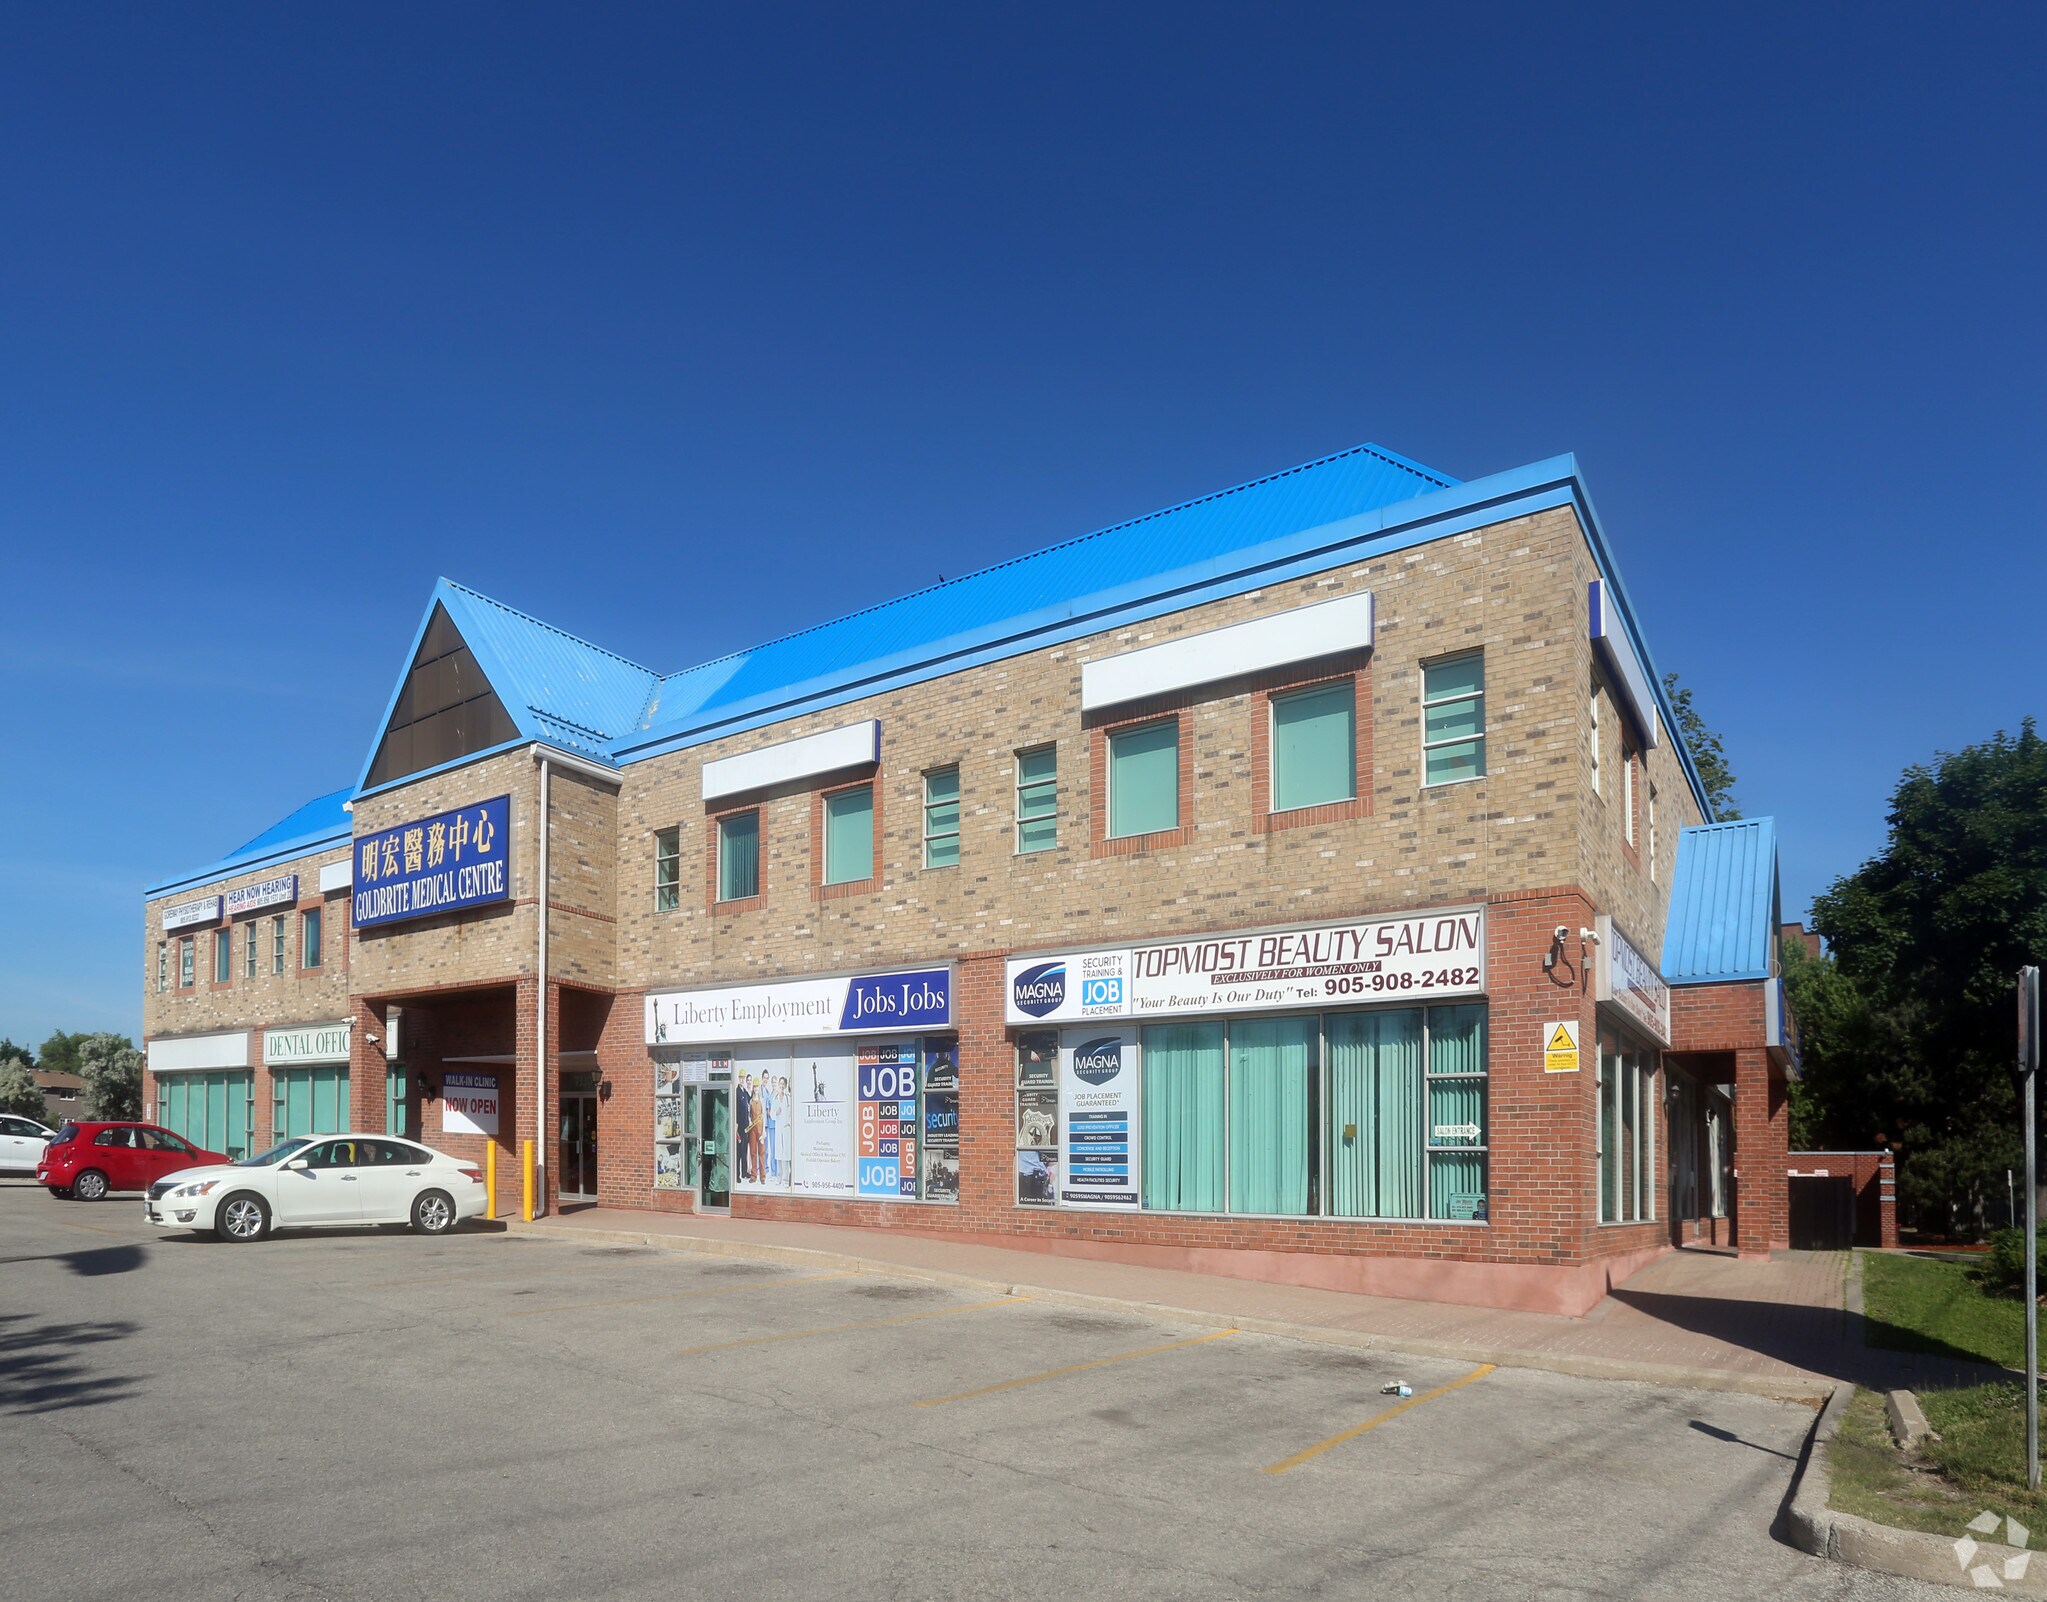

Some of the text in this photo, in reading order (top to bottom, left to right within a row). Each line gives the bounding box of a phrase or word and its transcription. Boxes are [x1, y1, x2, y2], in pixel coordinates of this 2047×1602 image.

[361, 809, 495, 883] 明宏醫務中心
[229, 877, 291, 905] HEAR NOW HEARING
[355, 860, 503, 922] GOLDBRITE MEDICAL CENTRE
[228, 901, 246, 912] HEARING
[247, 899, 256, 908] AIDS
[1134, 916, 1479, 979] TOPMOST BEAUTY SALON
[1082, 955, 1123, 969] SECURITY
[1082, 967, 1123, 979] TRAINING &
[1213, 961, 1379, 984] EXCLUSIVELY FOR WOMEN ONLY
[1015, 981, 1063, 1000] MAGNA
[1085, 980, 1120, 1004] JOB
[1296, 967, 1479, 999] Tel: 905-908-2482
[852, 982, 945, 1019] Jobs Jobs
[1133, 986, 1294, 1009] "Your Beauty Is Our Duty"
[674, 996, 832, 1028] Liberty Employment
[1082, 1005, 1123, 1016] PLACEMENT
[269, 1030, 350, 1057] DENTAL OFFIC
[859, 1050, 877, 1060] JOB
[880, 1048, 898, 1059] JOB
[1075, 1054, 1119, 1070] MAGNA
[445, 1074, 496, 1088] WALK-IN CLINIC
[863, 1067, 916, 1098] JOB
[445, 1097, 497, 1114] NOW OPEN
[1087, 1092, 1122, 1100] PLACEMENT
[807, 1104, 840, 1120] Liberty
[880, 1105, 898, 1116] JOB
[862, 1105, 874, 1153] JOB
[880, 1124, 898, 1135] JOB
[1436, 1126, 1475, 1135] SALON ENTRANCE
[880, 1143, 898, 1153] JOB
[905, 1141, 915, 1174] JOB
[861, 1165, 897, 1187] JOB
